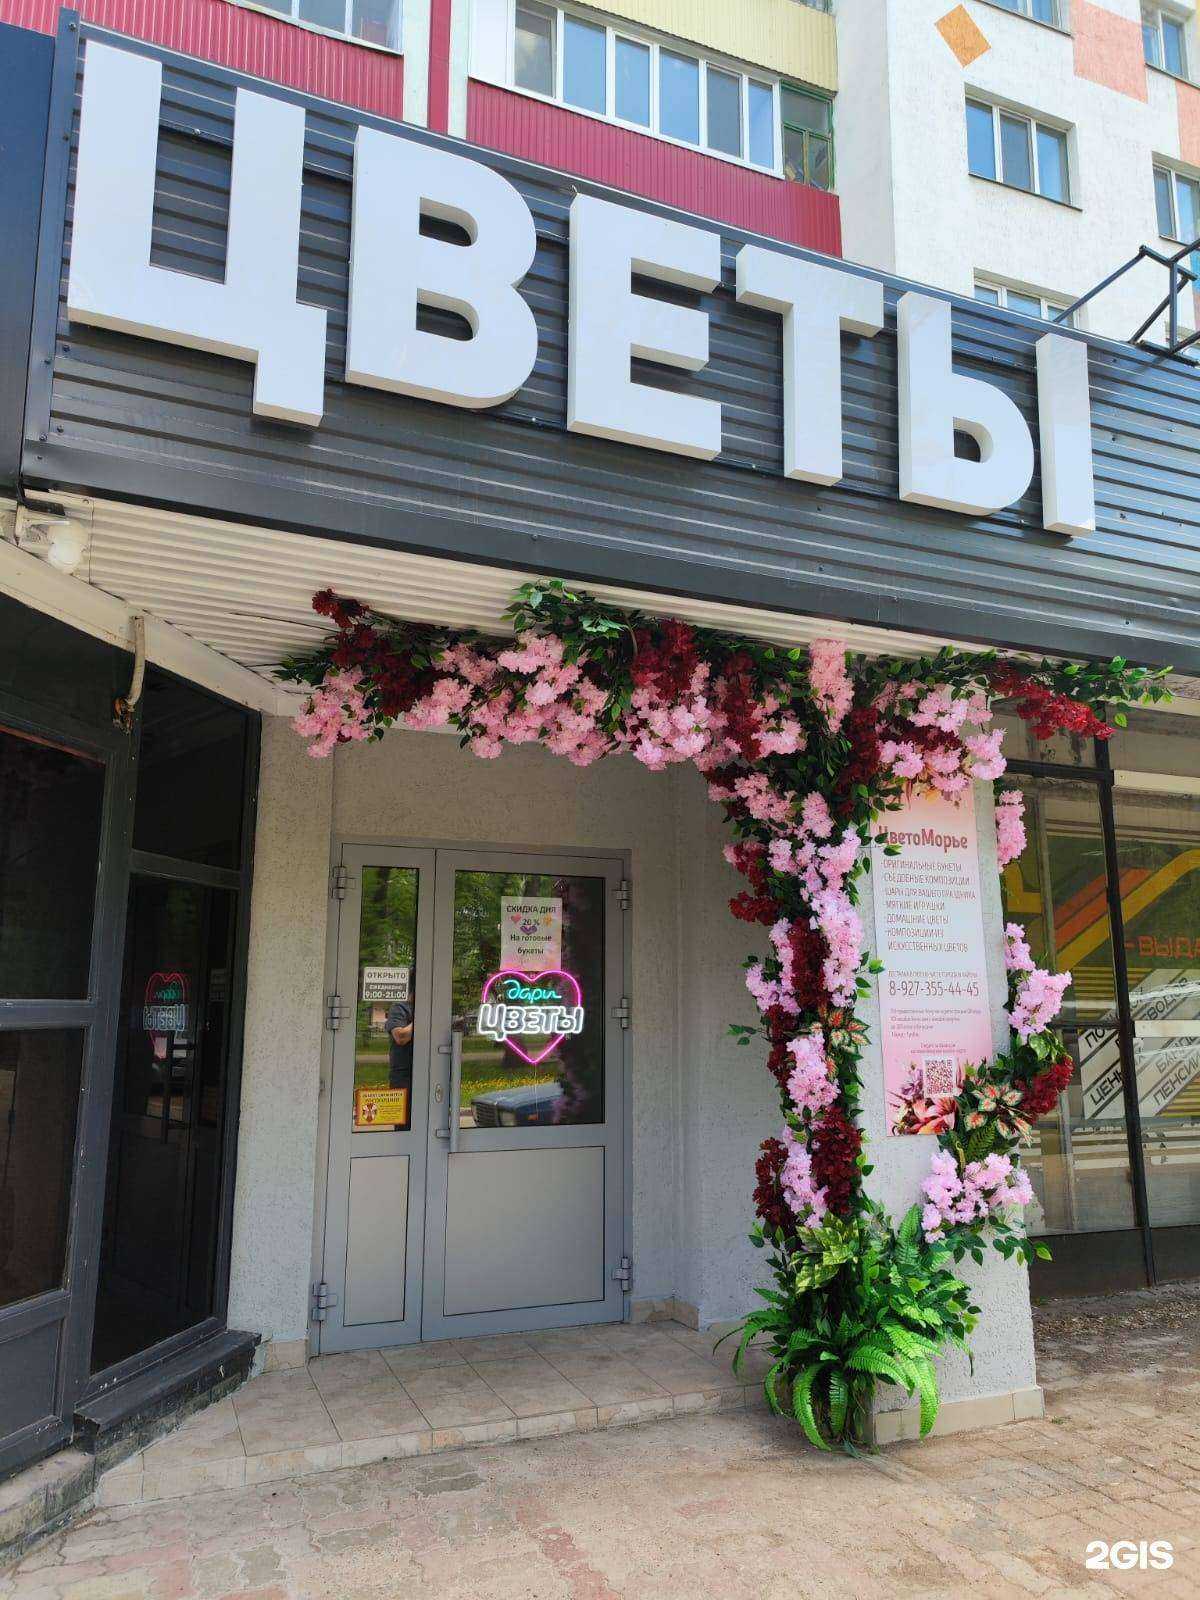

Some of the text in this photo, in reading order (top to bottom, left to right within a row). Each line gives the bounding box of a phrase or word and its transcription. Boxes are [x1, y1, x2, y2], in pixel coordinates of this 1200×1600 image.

[67, 41, 1096, 537] ЦВЕТЫ
[506, 905, 539, 913] СКИДКА
[510, 933, 520, 941] На
[517, 946, 544, 955] букеты
[367, 971, 406, 979] ОТКРЫТО
[503, 979, 562, 1004] дари
[889, 981, 979, 997] 8-927-355-44-45
